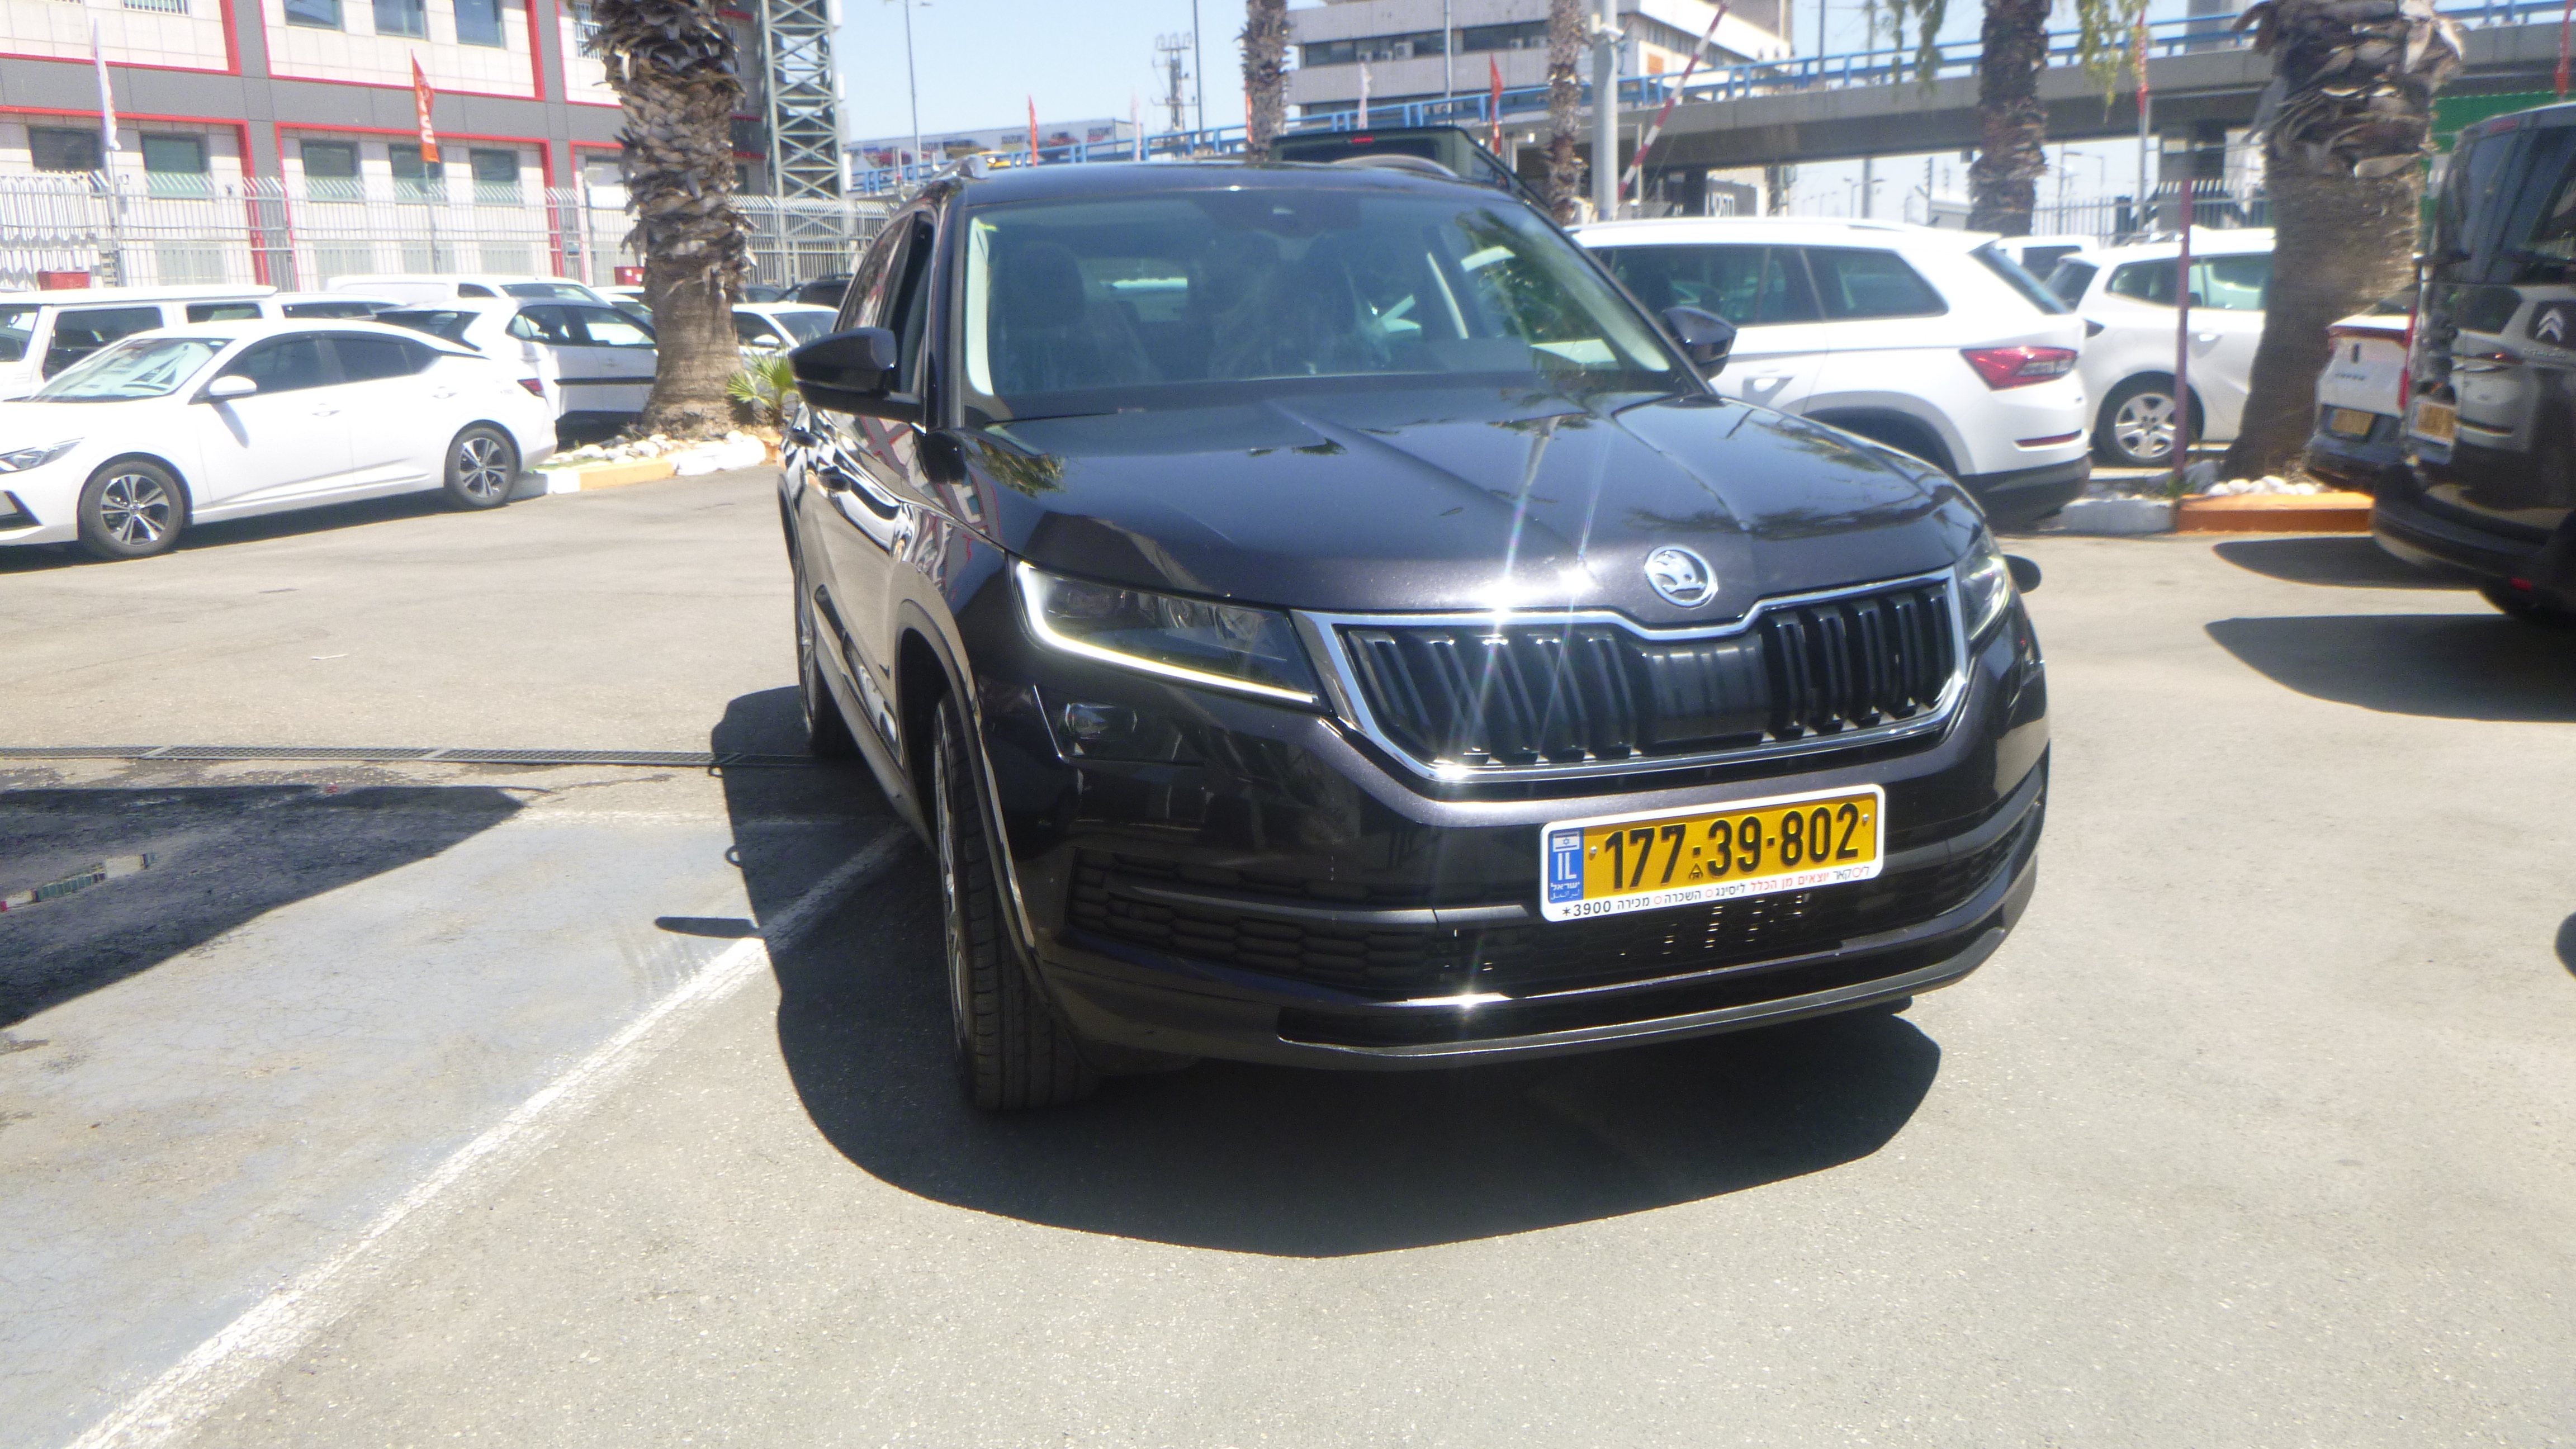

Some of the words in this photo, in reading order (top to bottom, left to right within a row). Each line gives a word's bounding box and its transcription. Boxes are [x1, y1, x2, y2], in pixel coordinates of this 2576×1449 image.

[1557, 852, 1577, 881] IL
[1750, 879, 1777, 892] הכלל
[1782, 878, 1793, 890] מן
[1798, 872, 1830, 886] יוצאים
[1550, 882, 1580, 891] ישראל
[1716, 883, 1746, 896] ליסינג
[1617, 897, 1650, 910] מכירה
[1664, 891, 1701, 904] השכרה
